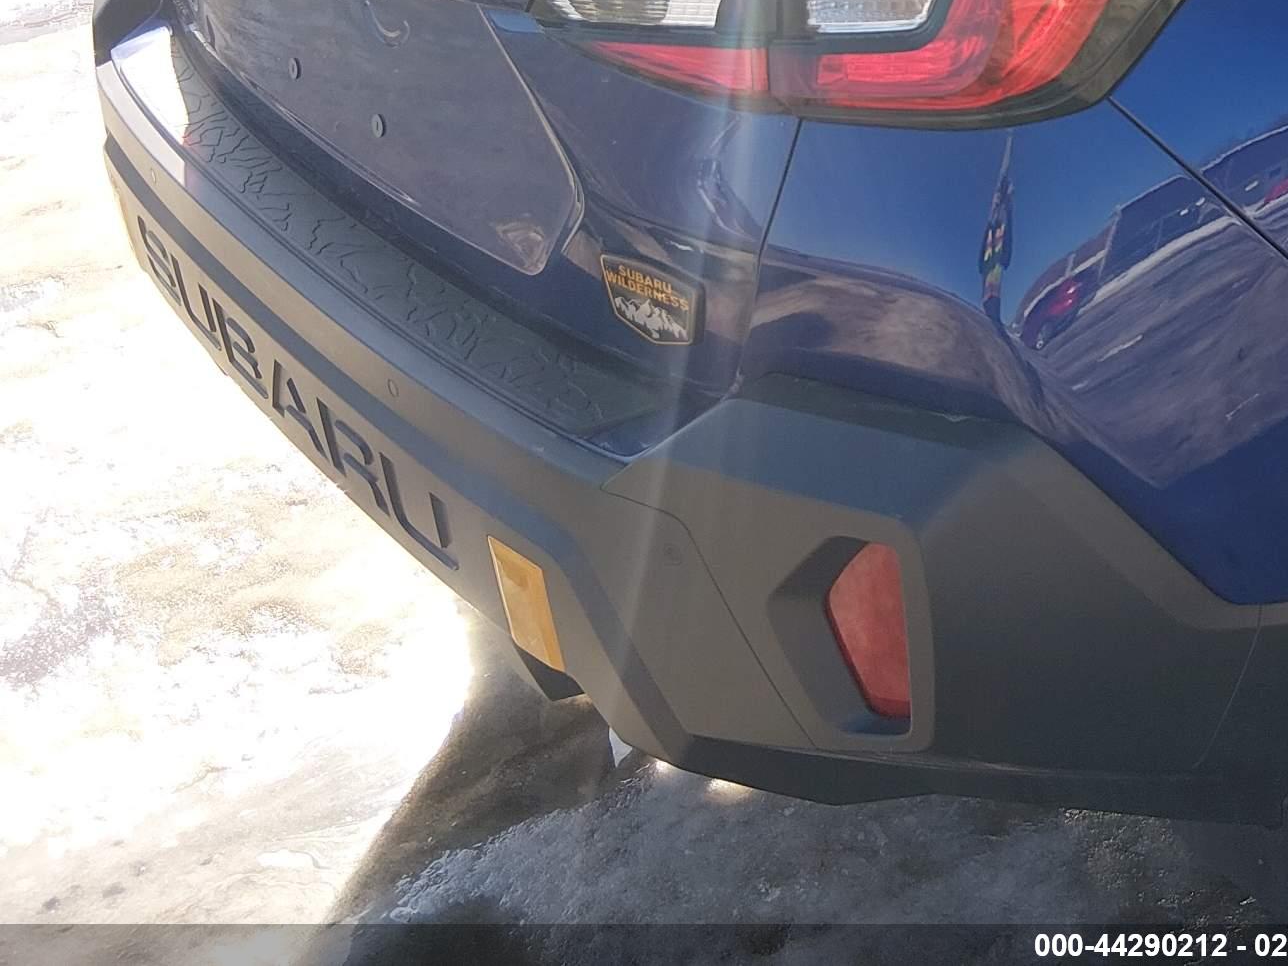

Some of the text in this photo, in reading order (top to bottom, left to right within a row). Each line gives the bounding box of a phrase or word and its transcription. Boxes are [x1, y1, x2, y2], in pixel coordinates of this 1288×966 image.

[605, 269, 689, 312] WILDERNESS
[618, 264, 673, 295] SUBARU
[137, 214, 460, 571] SUBARU
